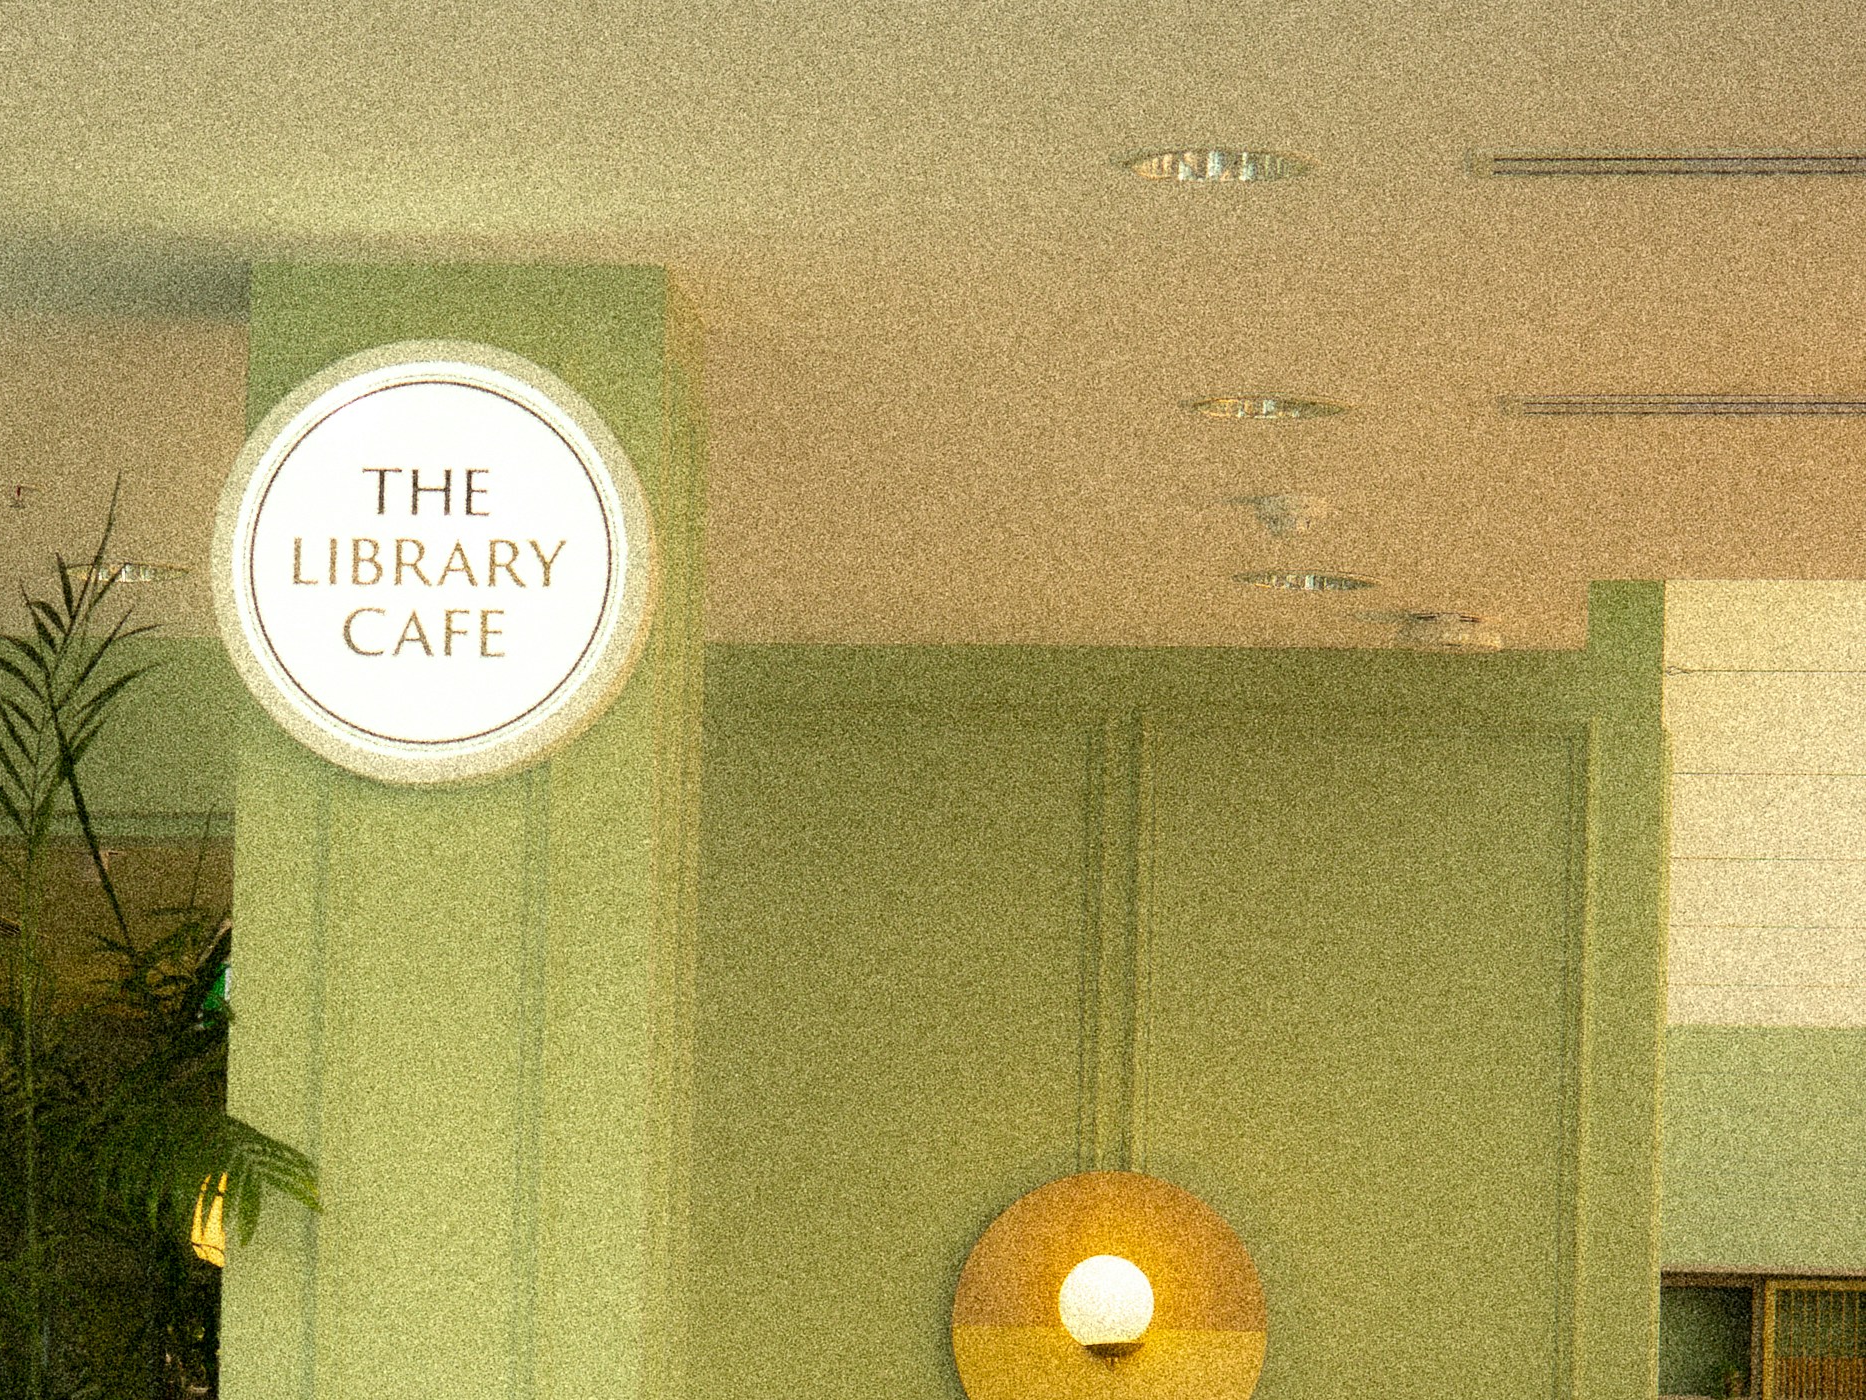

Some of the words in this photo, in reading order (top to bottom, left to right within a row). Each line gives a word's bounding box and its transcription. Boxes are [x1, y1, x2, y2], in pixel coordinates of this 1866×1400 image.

[362, 468, 490, 516] THE
[292, 537, 567, 587] LIBRARY
[343, 607, 505, 658] CAFE
